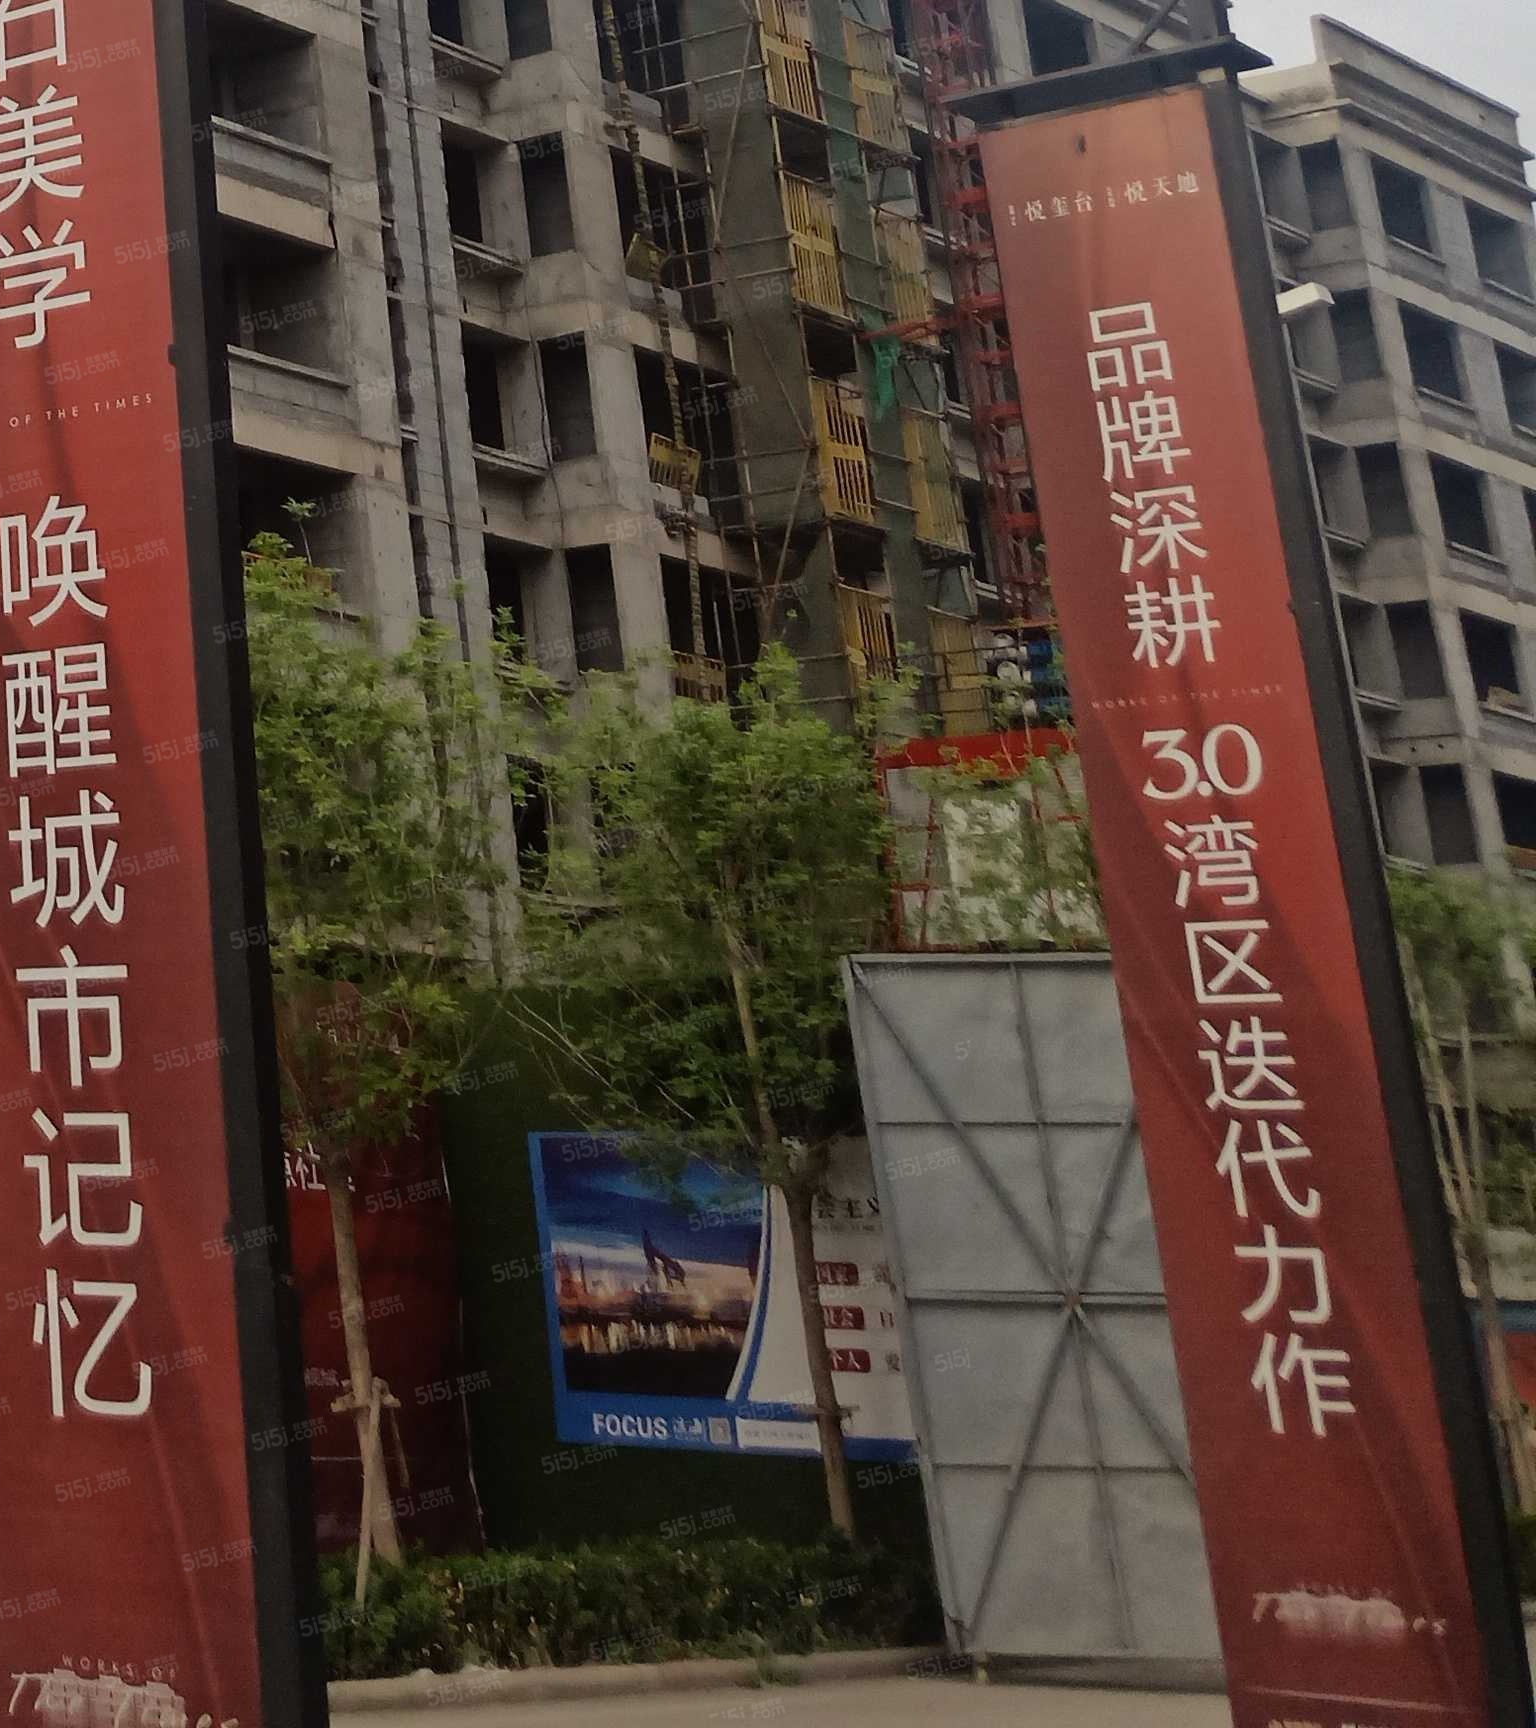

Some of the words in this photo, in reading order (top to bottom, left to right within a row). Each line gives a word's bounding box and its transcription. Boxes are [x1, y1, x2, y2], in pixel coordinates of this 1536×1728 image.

[1124, 171, 1200, 204] 悦天地
[9, 414, 33, 428] OF
[46, 405, 80, 421] THE
[94, 392, 155, 413] TIMES
[1086, 301, 1222, 669] 品牌深耕
[592, 1411, 669, 1441] FOCUS
